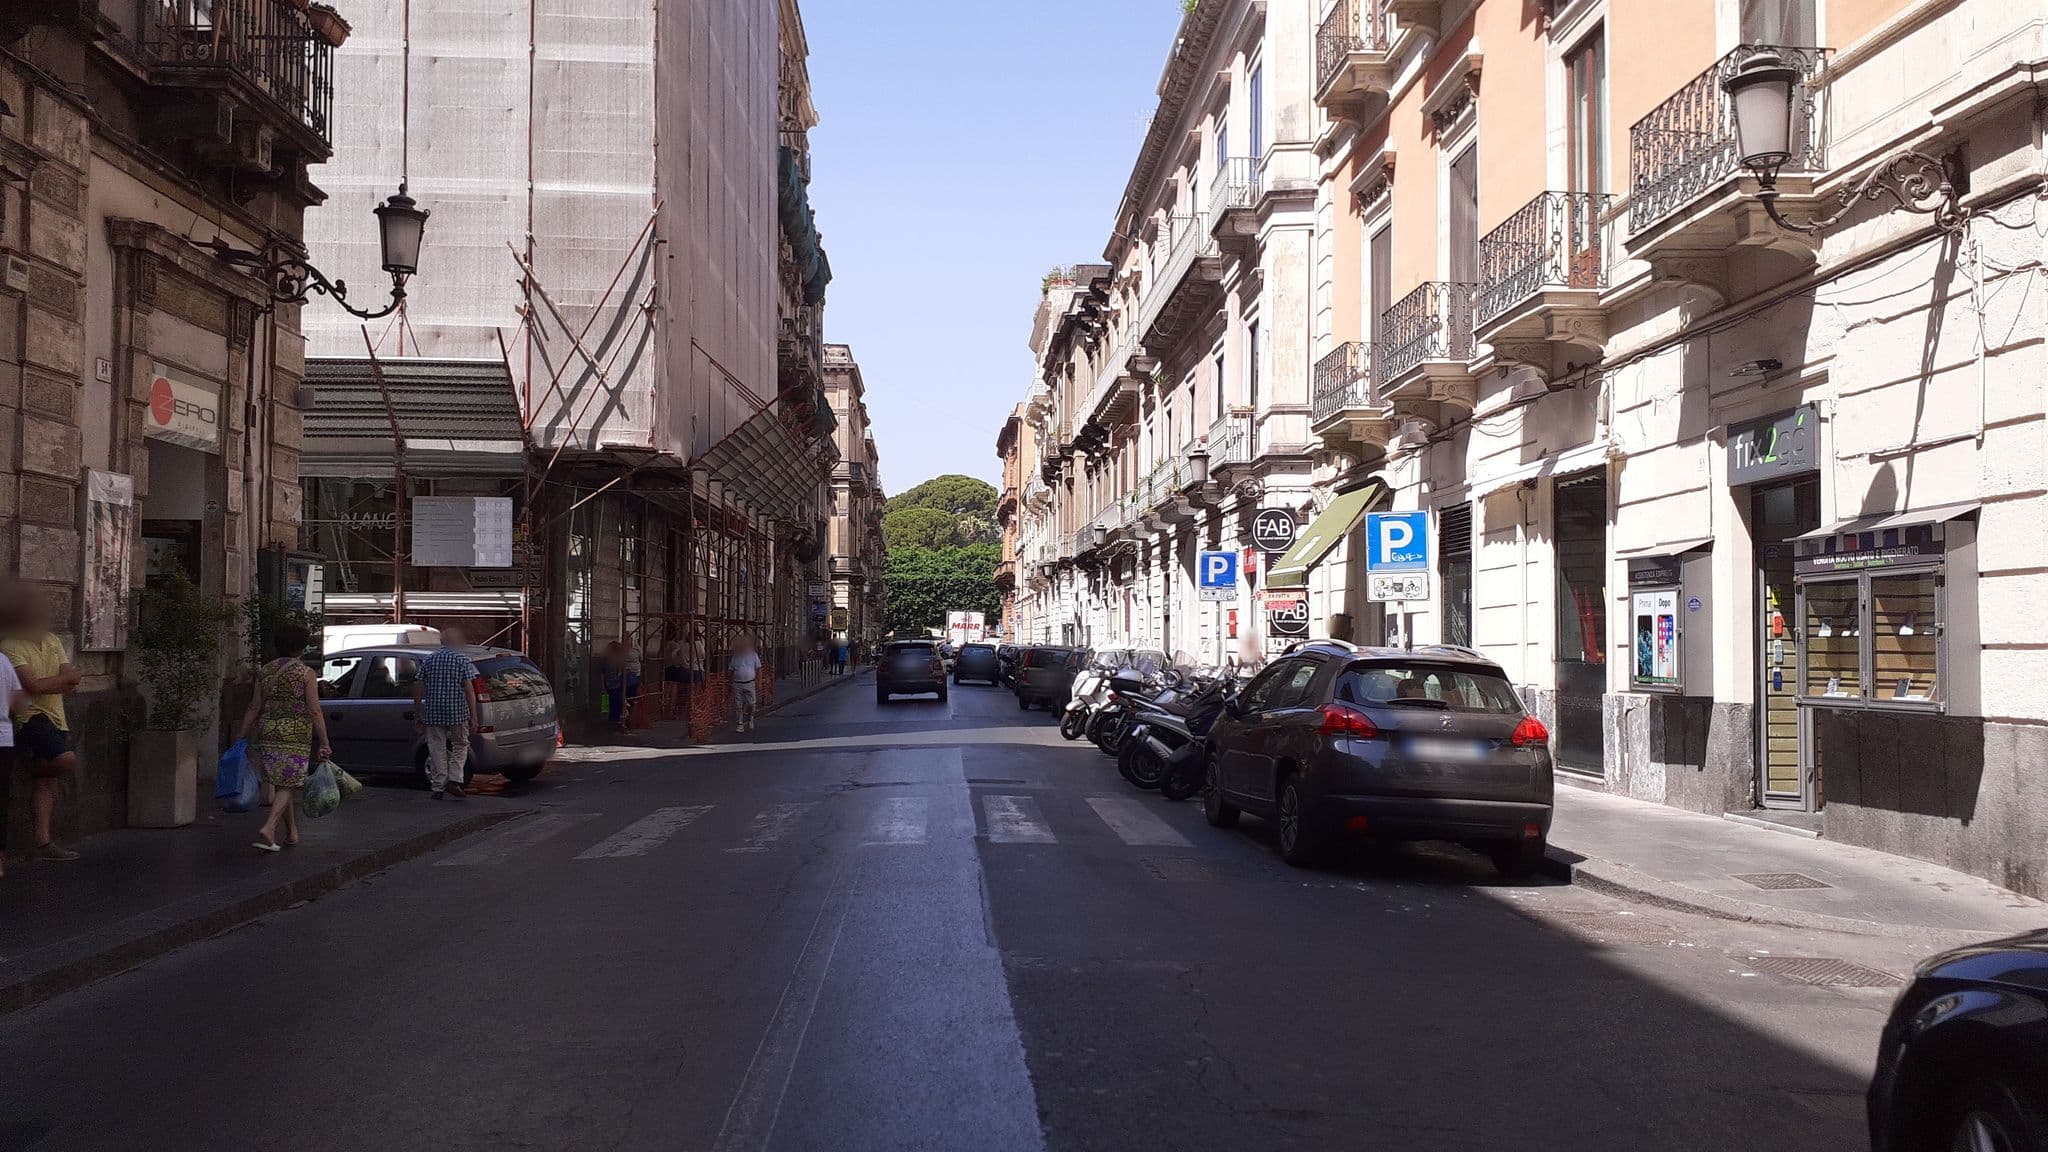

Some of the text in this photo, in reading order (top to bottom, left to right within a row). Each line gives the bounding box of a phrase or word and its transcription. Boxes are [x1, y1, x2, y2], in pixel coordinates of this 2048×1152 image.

[159, 393, 215, 424] ZERO
[1257, 519, 1291, 537] FAB
[1380, 520, 1413, 563] P
[1835, 552, 1855, 564] NUOVO
[1855, 549, 1874, 561] USATO
[1881, 545, 1919, 558] RIGENERATO
[1208, 556, 1228, 583] P
[1638, 597, 1671, 609] Prima Dopo
[951, 622, 981, 630] MARR
